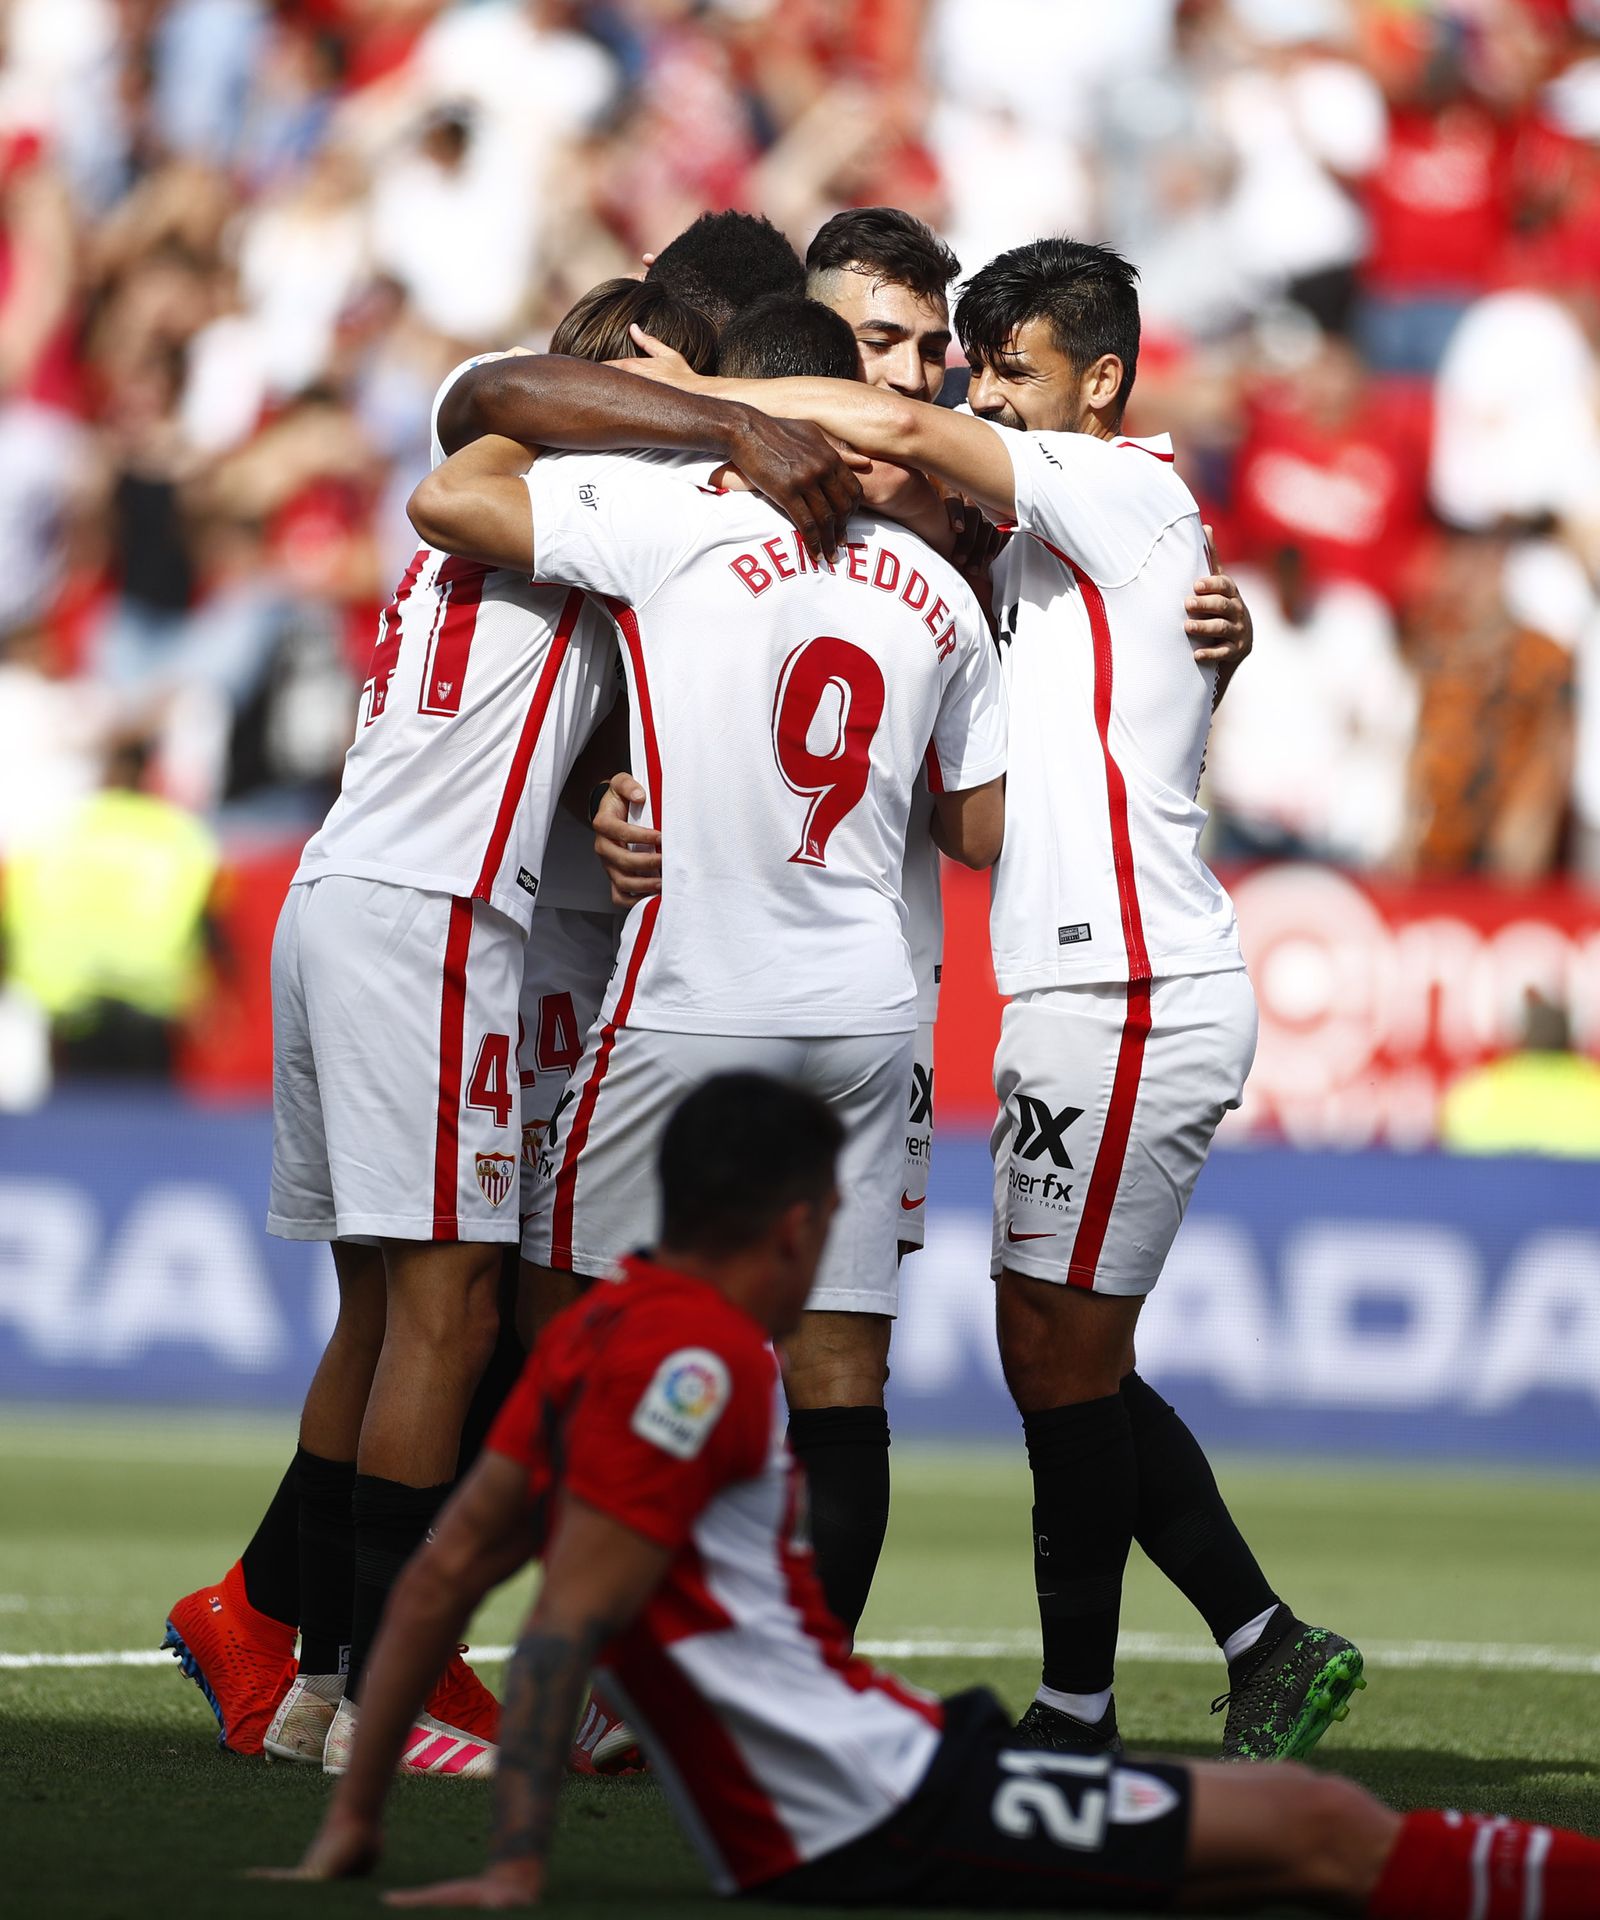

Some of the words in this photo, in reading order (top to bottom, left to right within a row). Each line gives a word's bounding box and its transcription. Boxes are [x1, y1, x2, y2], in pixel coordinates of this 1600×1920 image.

[578, 483, 600, 512] fair
[727, 529, 958, 665] BENEDDER
[771, 635, 886, 868] 9
[466, 1032, 513, 1129] 4
[1039, 1200, 1071, 1213] TRADE
[993, 1750, 1111, 1850] 21
